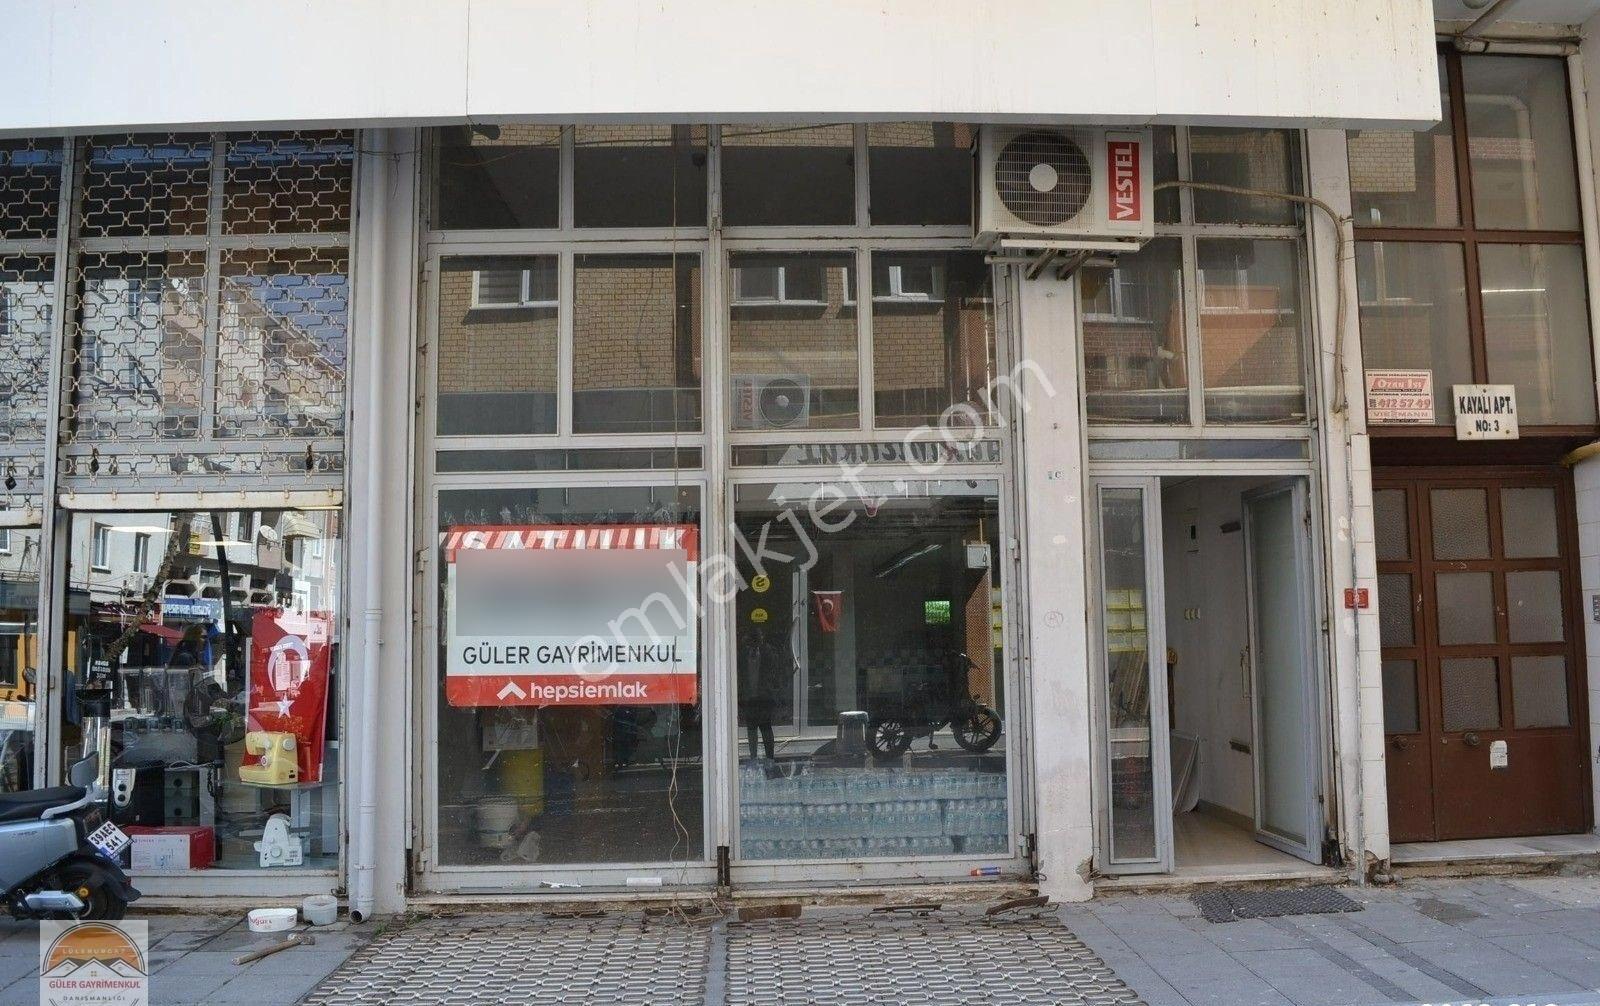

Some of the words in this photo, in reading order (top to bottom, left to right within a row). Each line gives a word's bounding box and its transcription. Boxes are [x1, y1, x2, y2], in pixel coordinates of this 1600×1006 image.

[1115, 143, 1134, 219] VESTEL
[1459, 396, 1491, 414] KAYALI
[1494, 396, 1514, 414] APT.
[1475, 419, 1491, 432] NO:
[1494, 419, 1500, 432] 3
[462, 641, 530, 665] GÜLER
[536, 640, 683, 664] GAYRİMENKUL
[530, 681, 648, 701] hepsiemlak
[105, 835, 123, 851] 541
